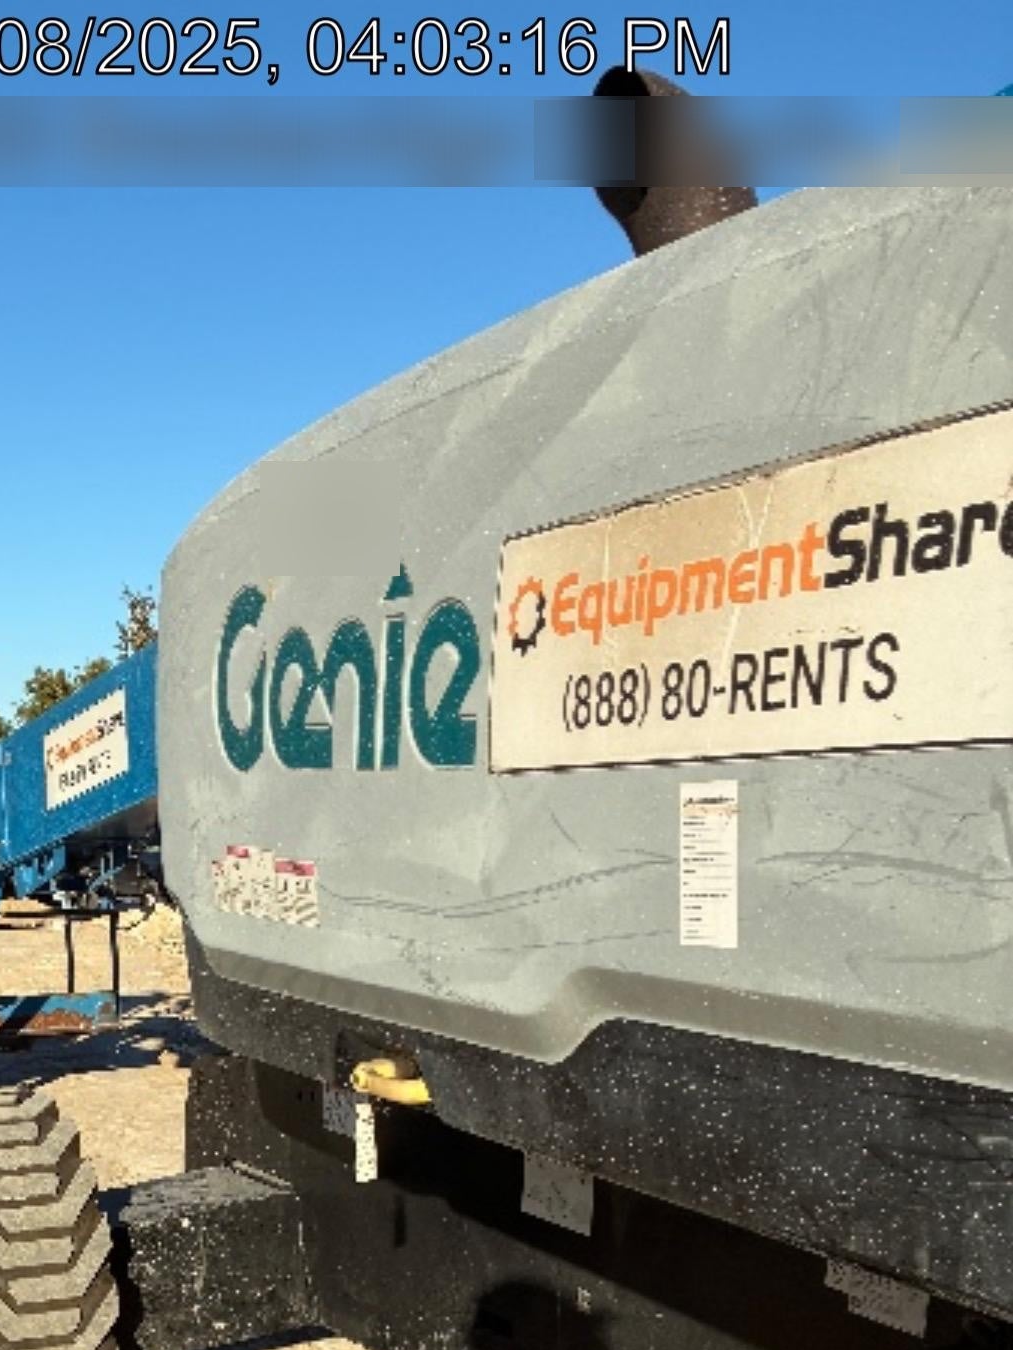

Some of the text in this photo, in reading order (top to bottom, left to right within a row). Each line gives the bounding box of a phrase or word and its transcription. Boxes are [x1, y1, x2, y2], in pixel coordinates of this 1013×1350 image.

[213, 561, 481, 773] Genie
[562, 632, 901, 733] (888) 80-RENTS
